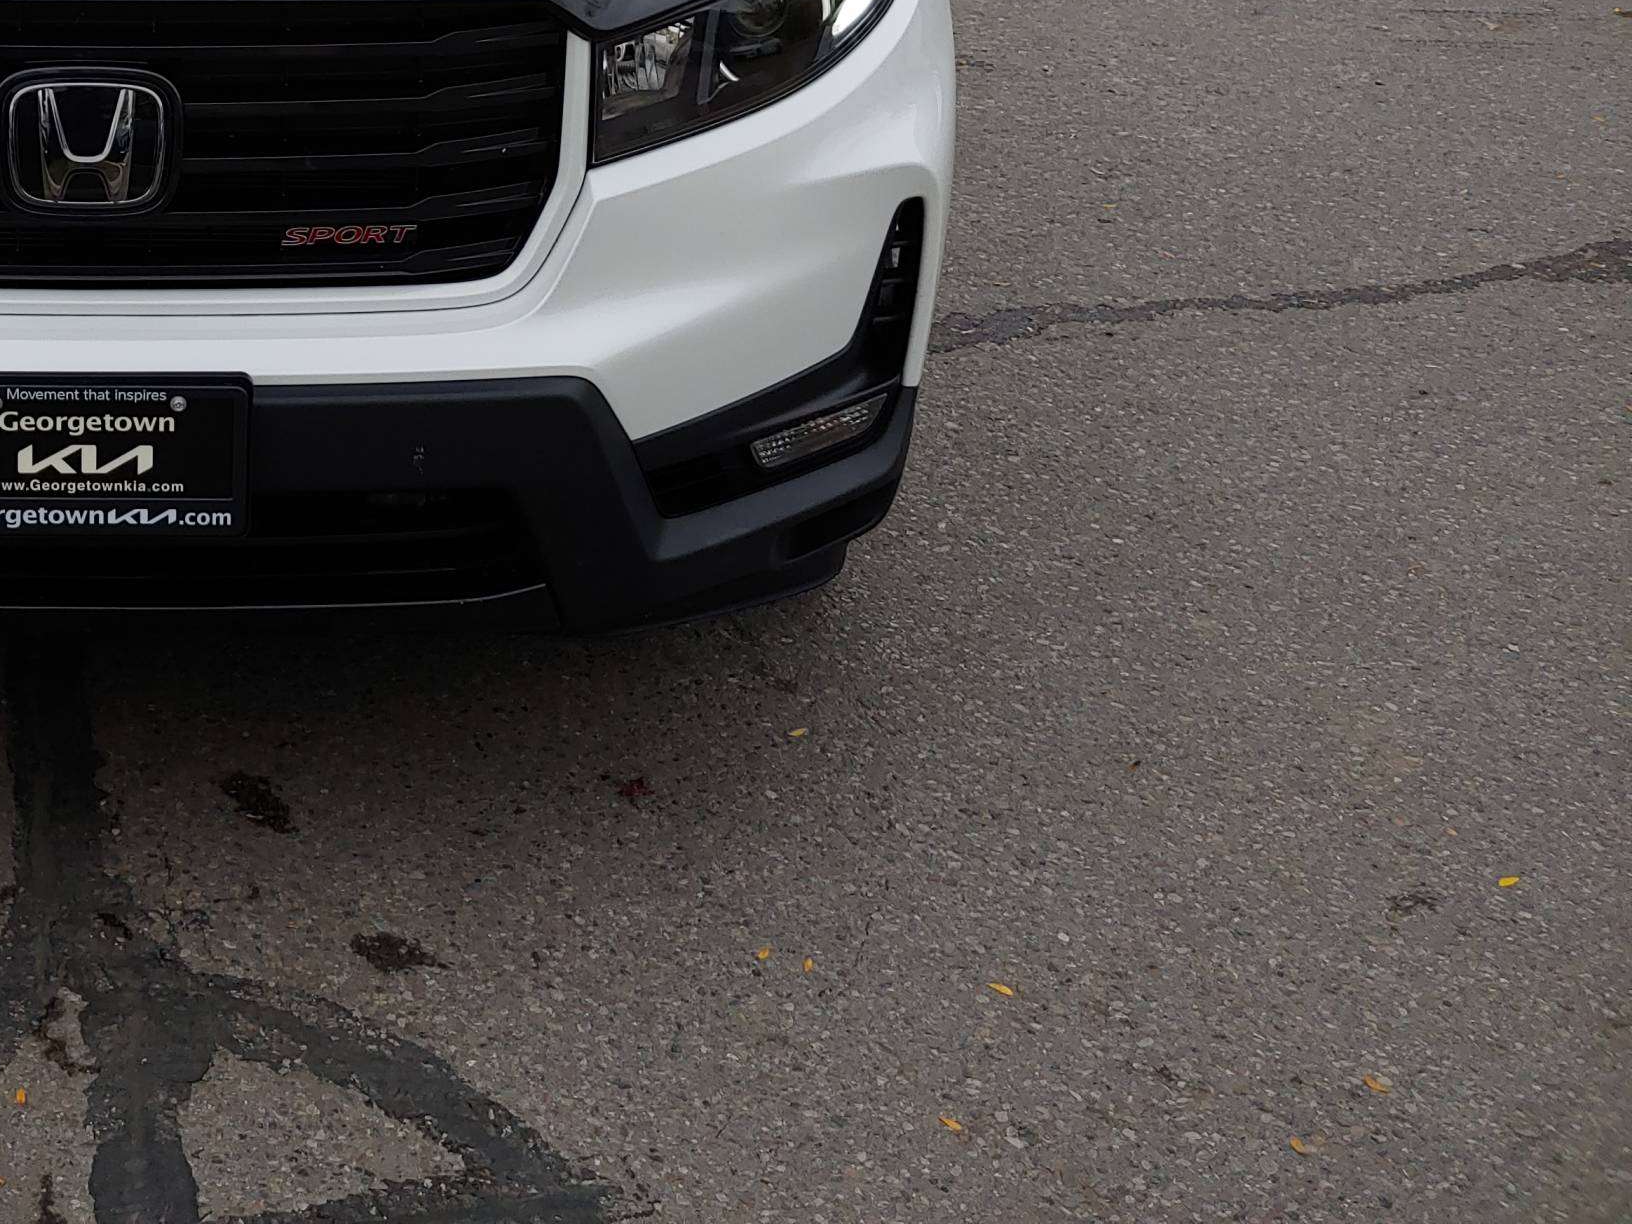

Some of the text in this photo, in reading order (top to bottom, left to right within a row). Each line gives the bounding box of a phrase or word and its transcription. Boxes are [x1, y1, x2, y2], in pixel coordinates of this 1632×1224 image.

[281, 224, 418, 246] SPORT
[6, 388, 167, 403] Movement that inspires
